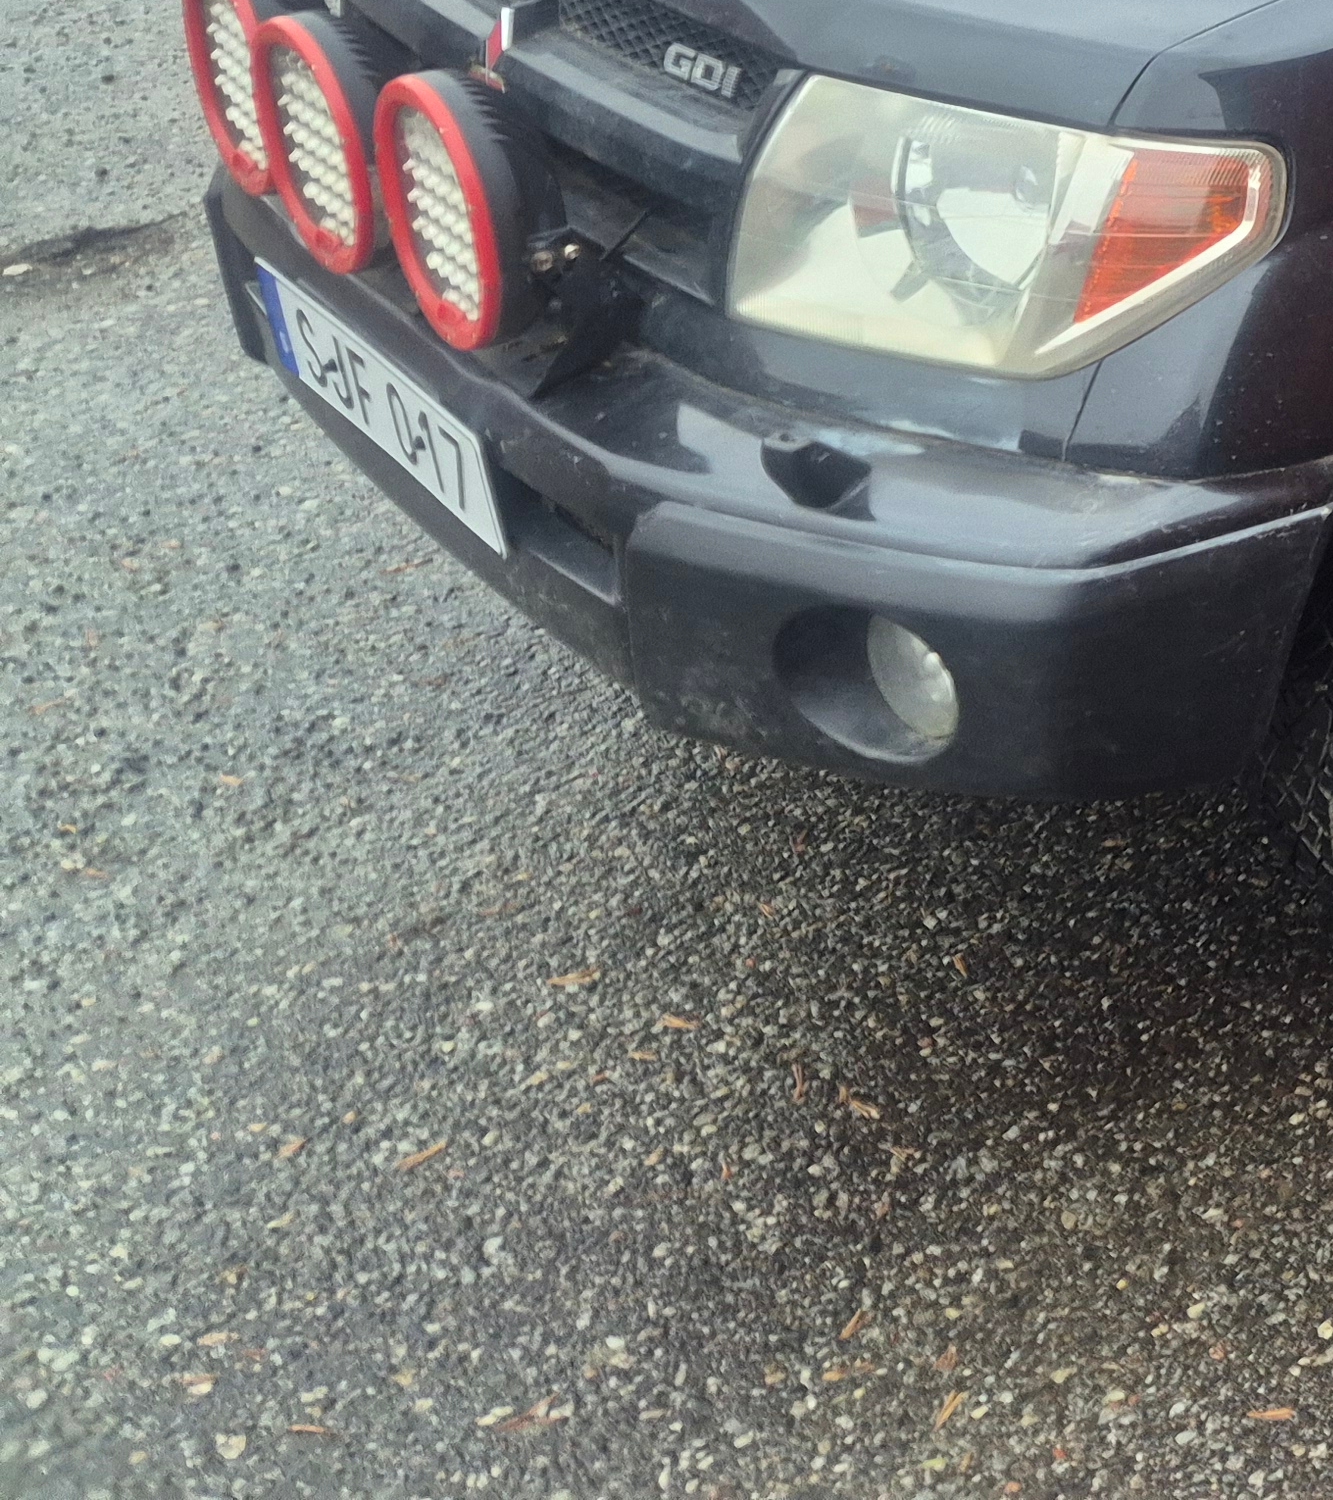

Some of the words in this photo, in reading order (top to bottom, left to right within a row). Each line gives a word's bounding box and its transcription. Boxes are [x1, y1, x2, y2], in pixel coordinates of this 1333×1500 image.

[663, 42, 741, 98] GDI
[296, 308, 371, 426] SJF
[386, 382, 465, 512] 017
